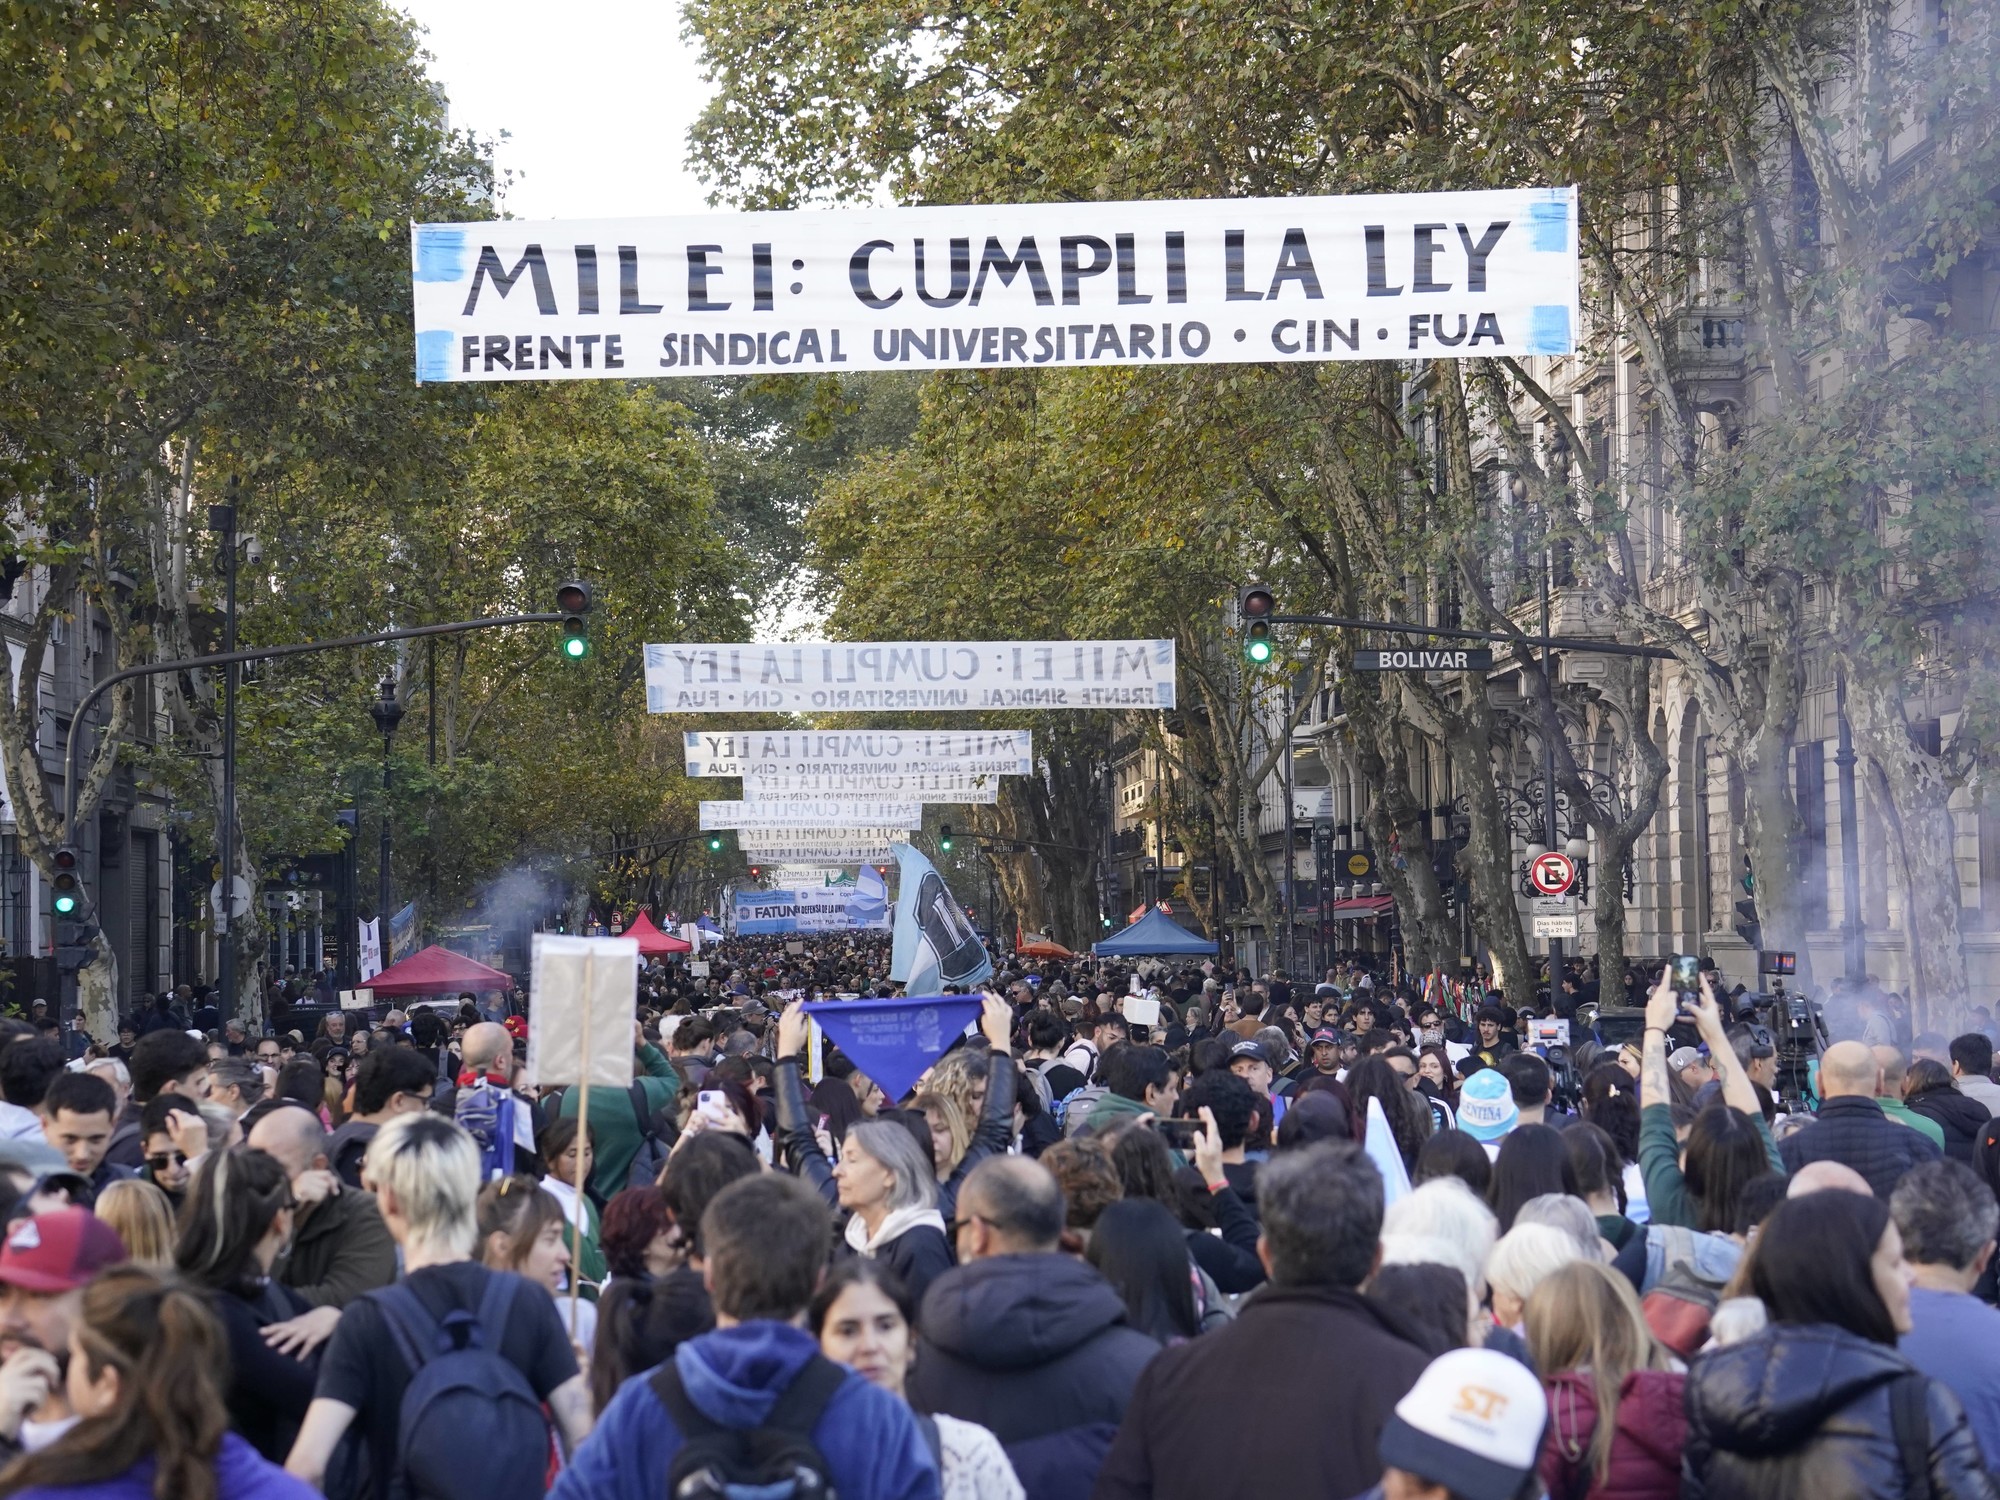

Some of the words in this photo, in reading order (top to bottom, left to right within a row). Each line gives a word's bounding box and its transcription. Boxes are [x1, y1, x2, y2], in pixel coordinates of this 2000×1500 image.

[462, 243, 804, 316] MILEI:
[848, 231, 1187, 309] CUMPLI
[1224, 227, 1324, 302] LA
[1364, 220, 1511, 297] LEY
[462, 333, 624, 373] FRENTE
[660, 328, 847, 368] SINDICAL
[873, 321, 1211, 363] UNIVERSITARIO
[1271, 318, 1360, 354] CIN
[1408, 312, 1505, 350] FUA
[1379, 652, 1468, 668] BOLIVAR
[993, 845, 1014, 853] PERU
[755, 905, 796, 918] FATUN
[801, 904, 821, 914] DEFENSA
[822, 904, 828, 914] DE
[828, 904, 835, 914] LA
